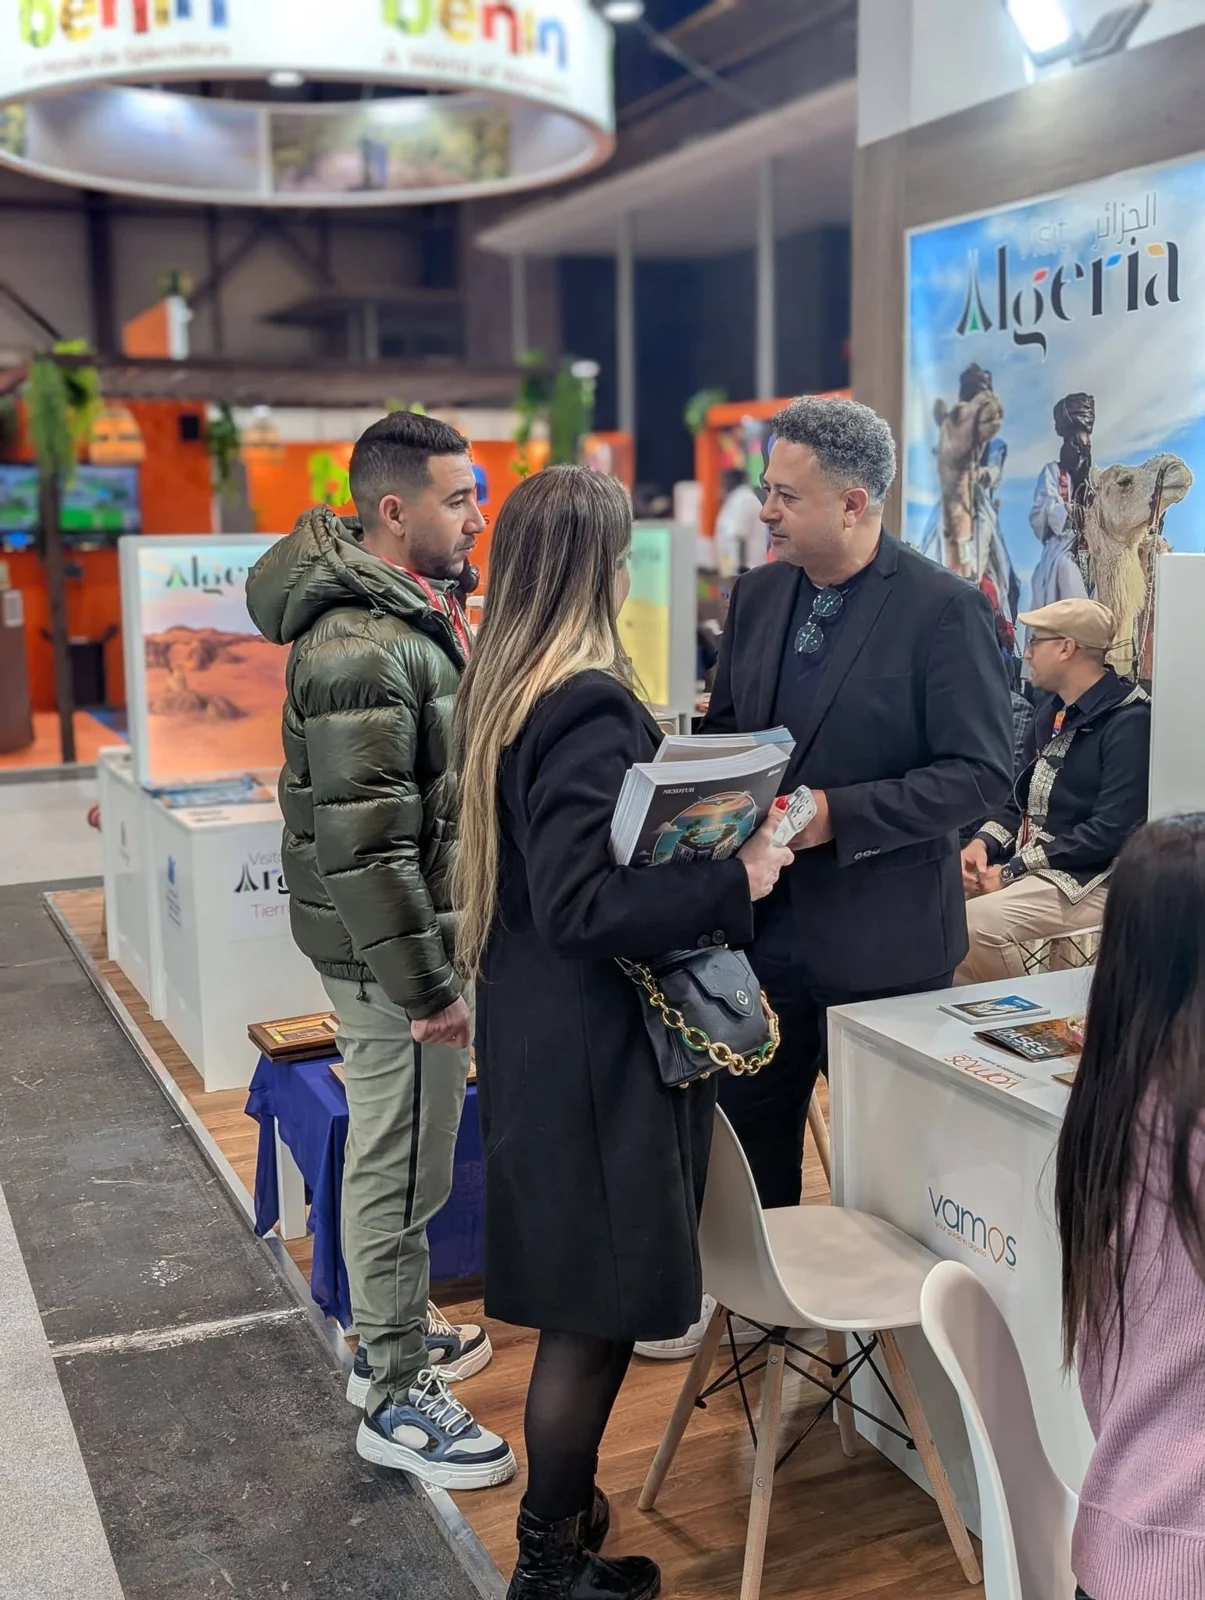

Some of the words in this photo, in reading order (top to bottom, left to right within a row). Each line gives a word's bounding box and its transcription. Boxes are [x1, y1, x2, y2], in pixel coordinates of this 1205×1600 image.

[956, 235, 1181, 361] Algeria
[165, 554, 245, 596] Alge
[233, 862, 292, 895] Arg
[250, 903, 291, 918] Tierr
[928, 1186, 1017, 1267] vamos
